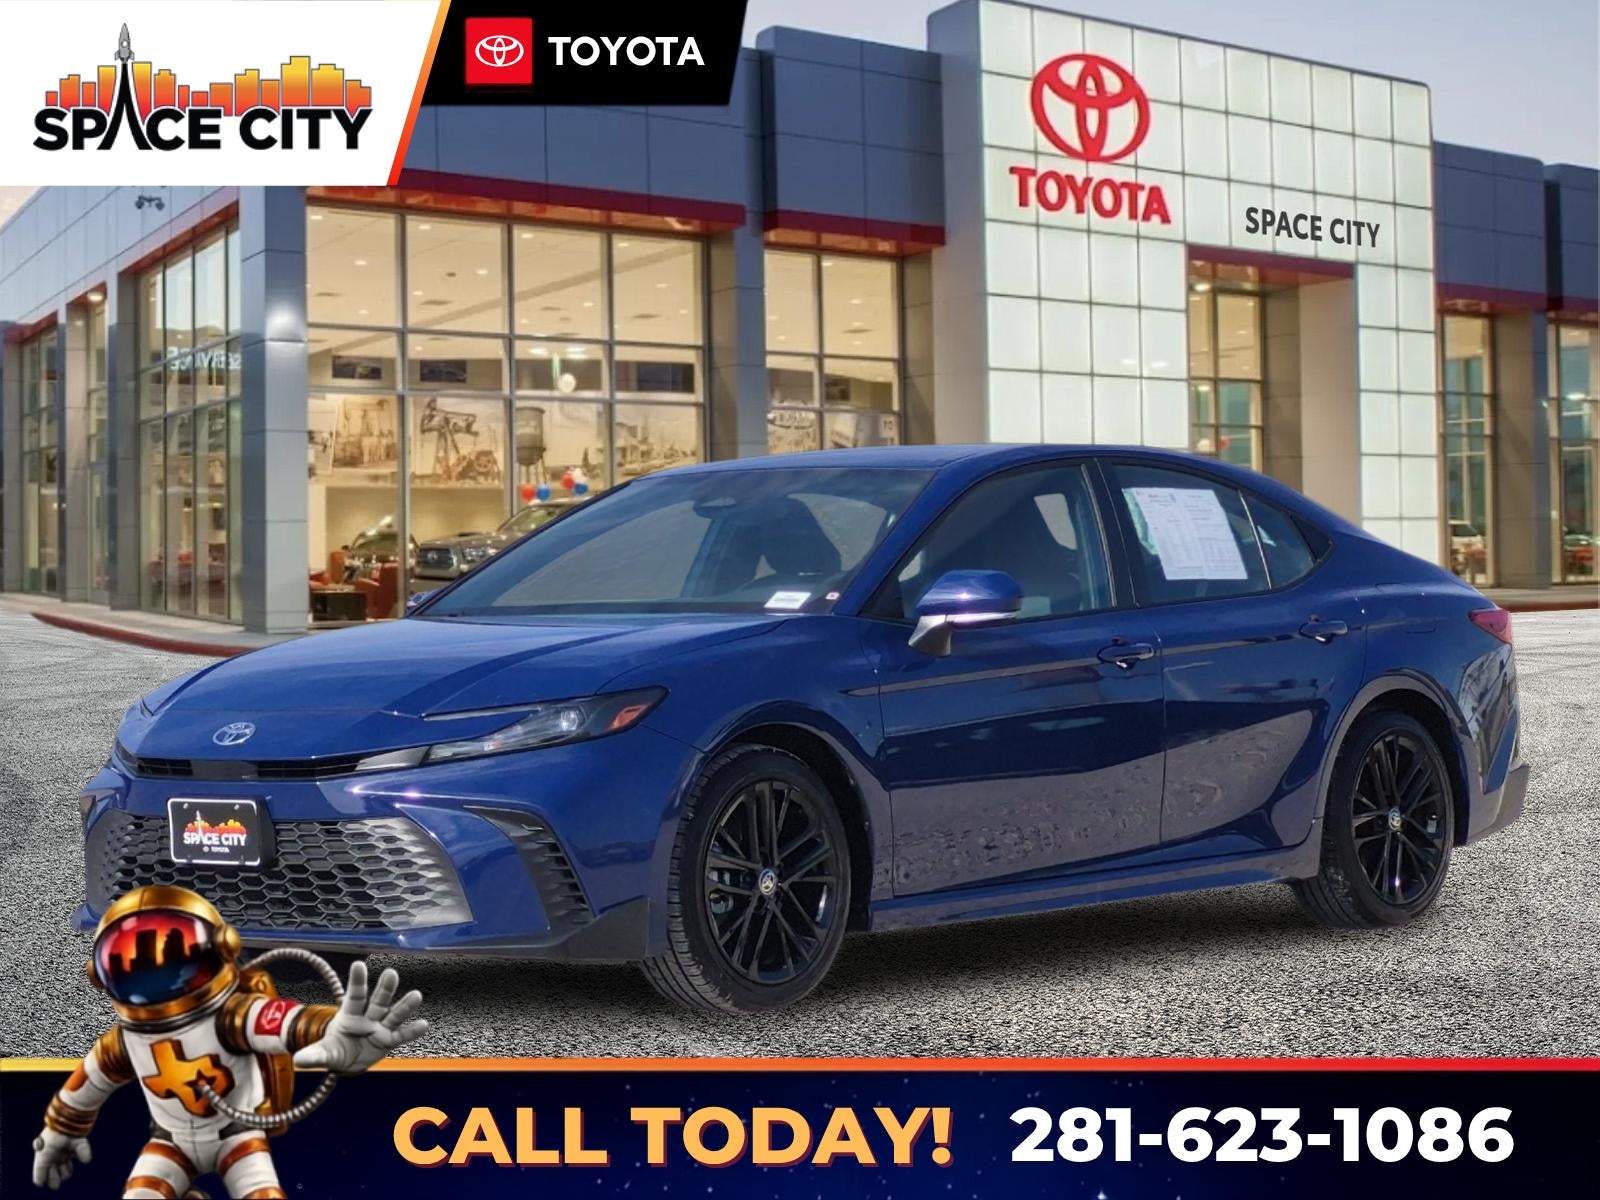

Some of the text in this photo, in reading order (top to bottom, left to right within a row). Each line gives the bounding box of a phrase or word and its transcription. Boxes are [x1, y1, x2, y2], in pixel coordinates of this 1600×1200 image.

[1009, 167, 1171, 224] TOYOTA
[1245, 206, 1381, 248] SPACE CITY
[183, 831, 247, 846] SPACE CITY
